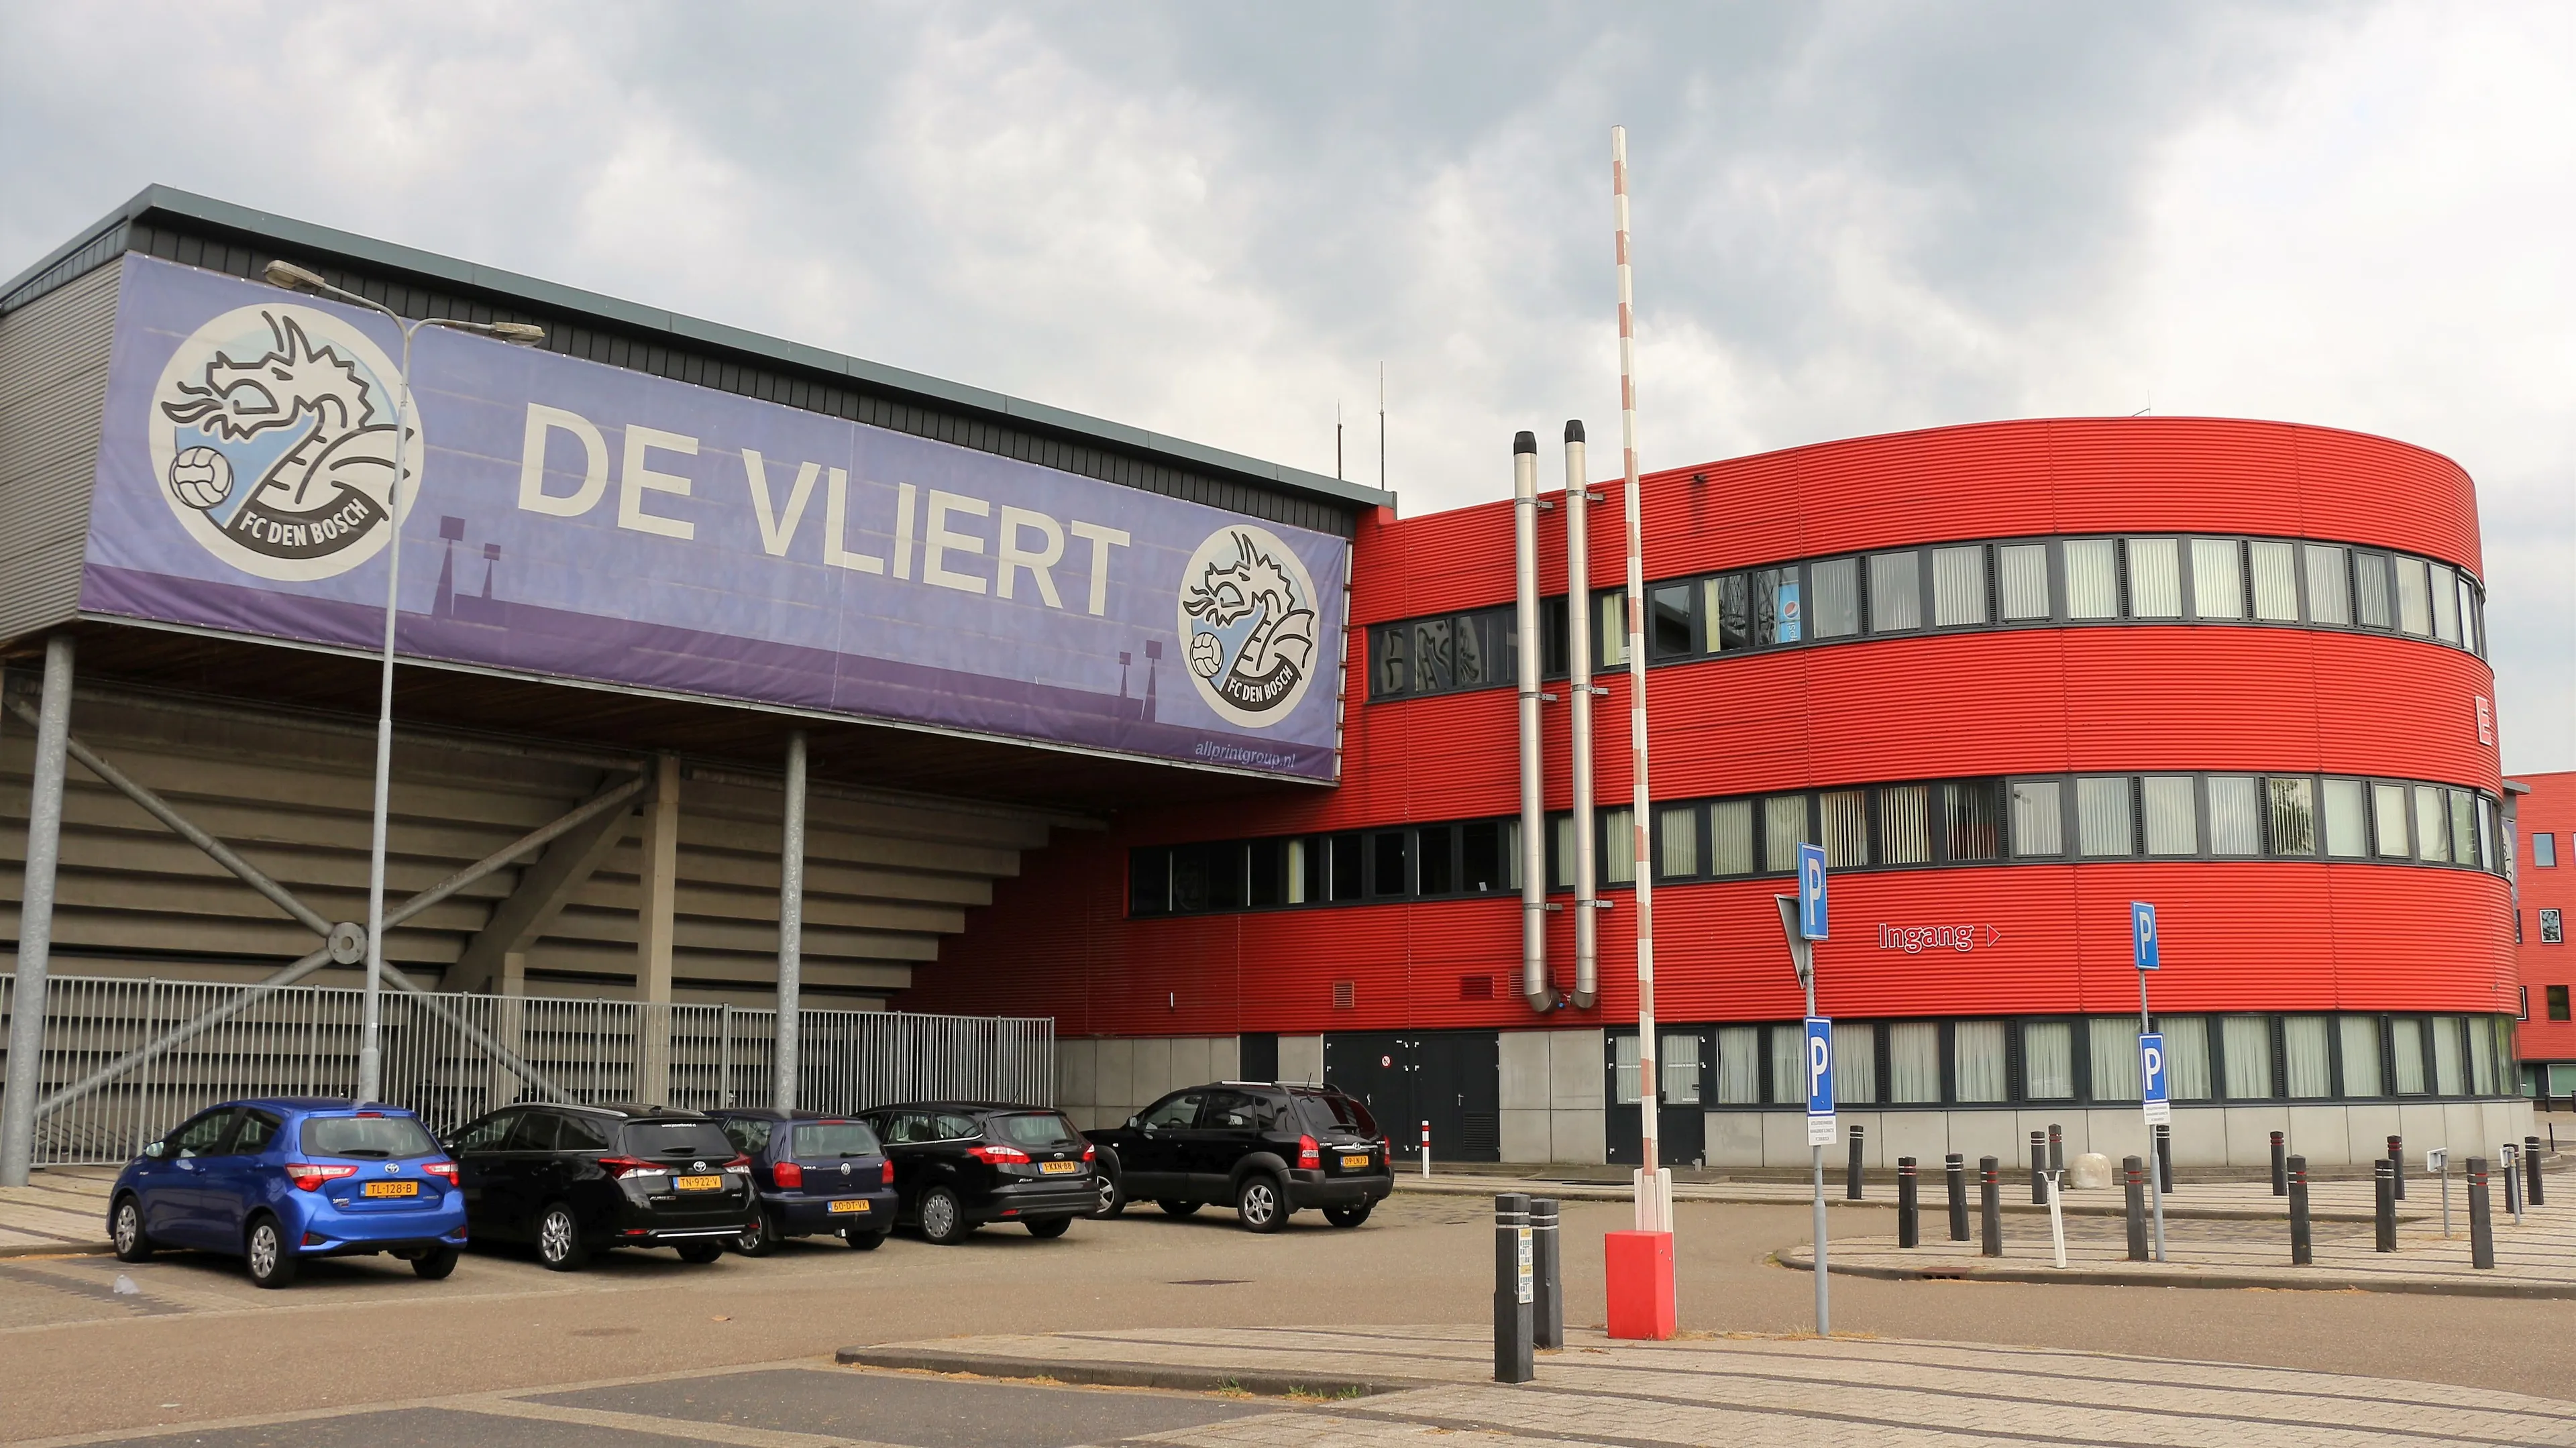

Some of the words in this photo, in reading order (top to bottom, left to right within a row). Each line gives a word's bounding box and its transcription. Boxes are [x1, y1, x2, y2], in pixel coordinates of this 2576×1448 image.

[238, 510, 268, 539] FC
[267, 521, 307, 547] DEN
[309, 498, 370, 545] BOSCH
[518, 402, 699, 540] DE
[741, 448, 1130, 616] VLIERT
[1227, 677, 1242, 698] FC
[1242, 684, 1263, 702] DEN
[1263, 664, 1293, 700] BOSCH
[2475, 695, 2492, 746] E
[1195, 740, 1296, 769] allprintgroup.nl
[1807, 857, 1821, 926] P
[1879, 923, 1975, 954] Ingang
[2139, 911, 2152, 960] P
[1811, 1035, 1829, 1097] P
[2144, 1047, 2161, 1091] P
[680, 1176, 717, 1188] TN-922-V
[1044, 1162, 1073, 1171] 1-KXN-88
[371, 1183, 412, 1194] TL-128-B
[834, 1201, 867, 1211] 60-DT-VK
